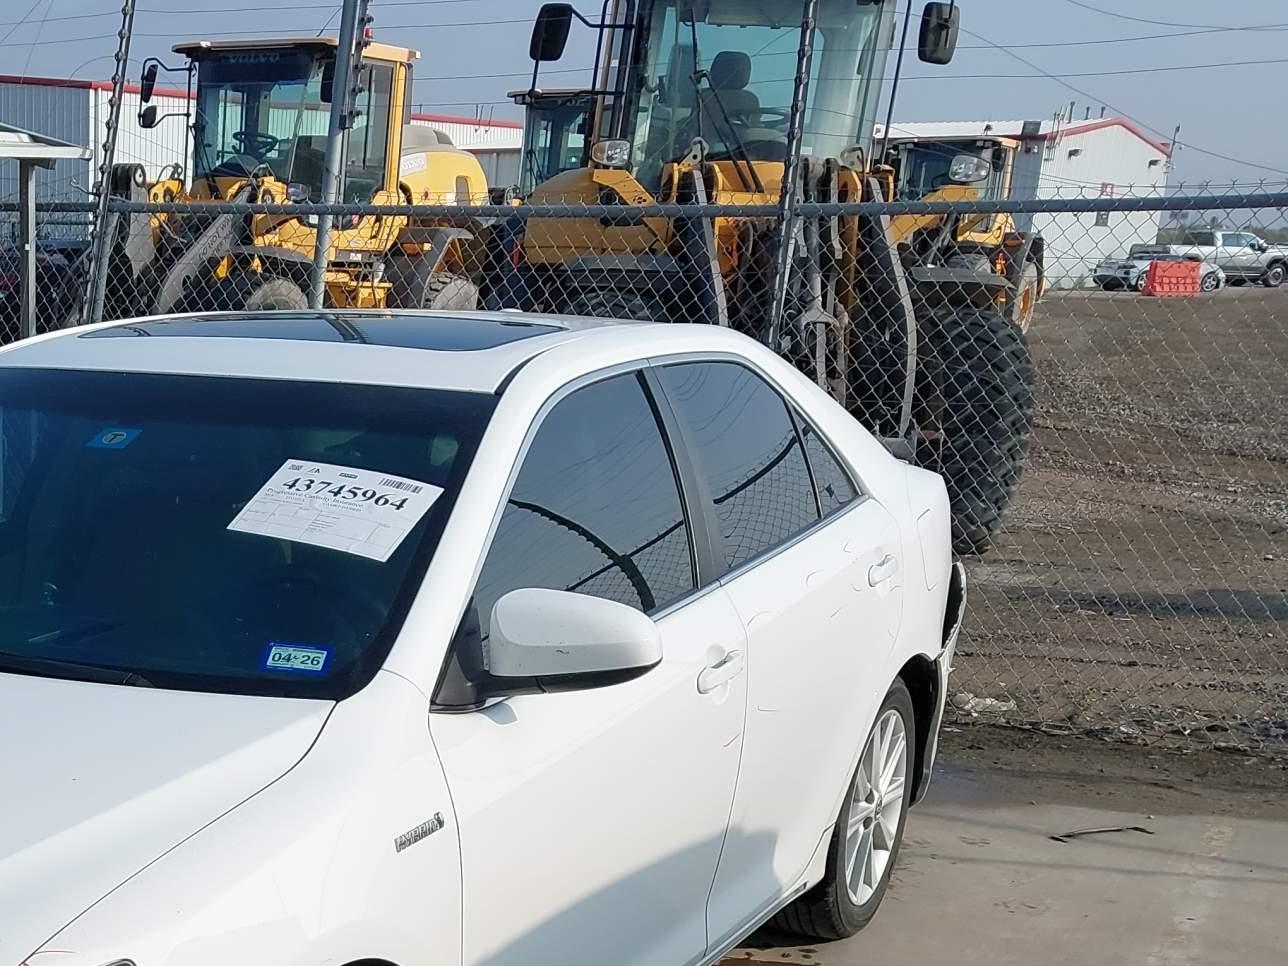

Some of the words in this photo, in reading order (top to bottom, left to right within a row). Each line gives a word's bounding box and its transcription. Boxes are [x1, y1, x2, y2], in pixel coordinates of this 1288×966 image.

[283, 477, 409, 511] 43745964
[272, 652, 293, 663] 04
[300, 654, 322, 666] 26
